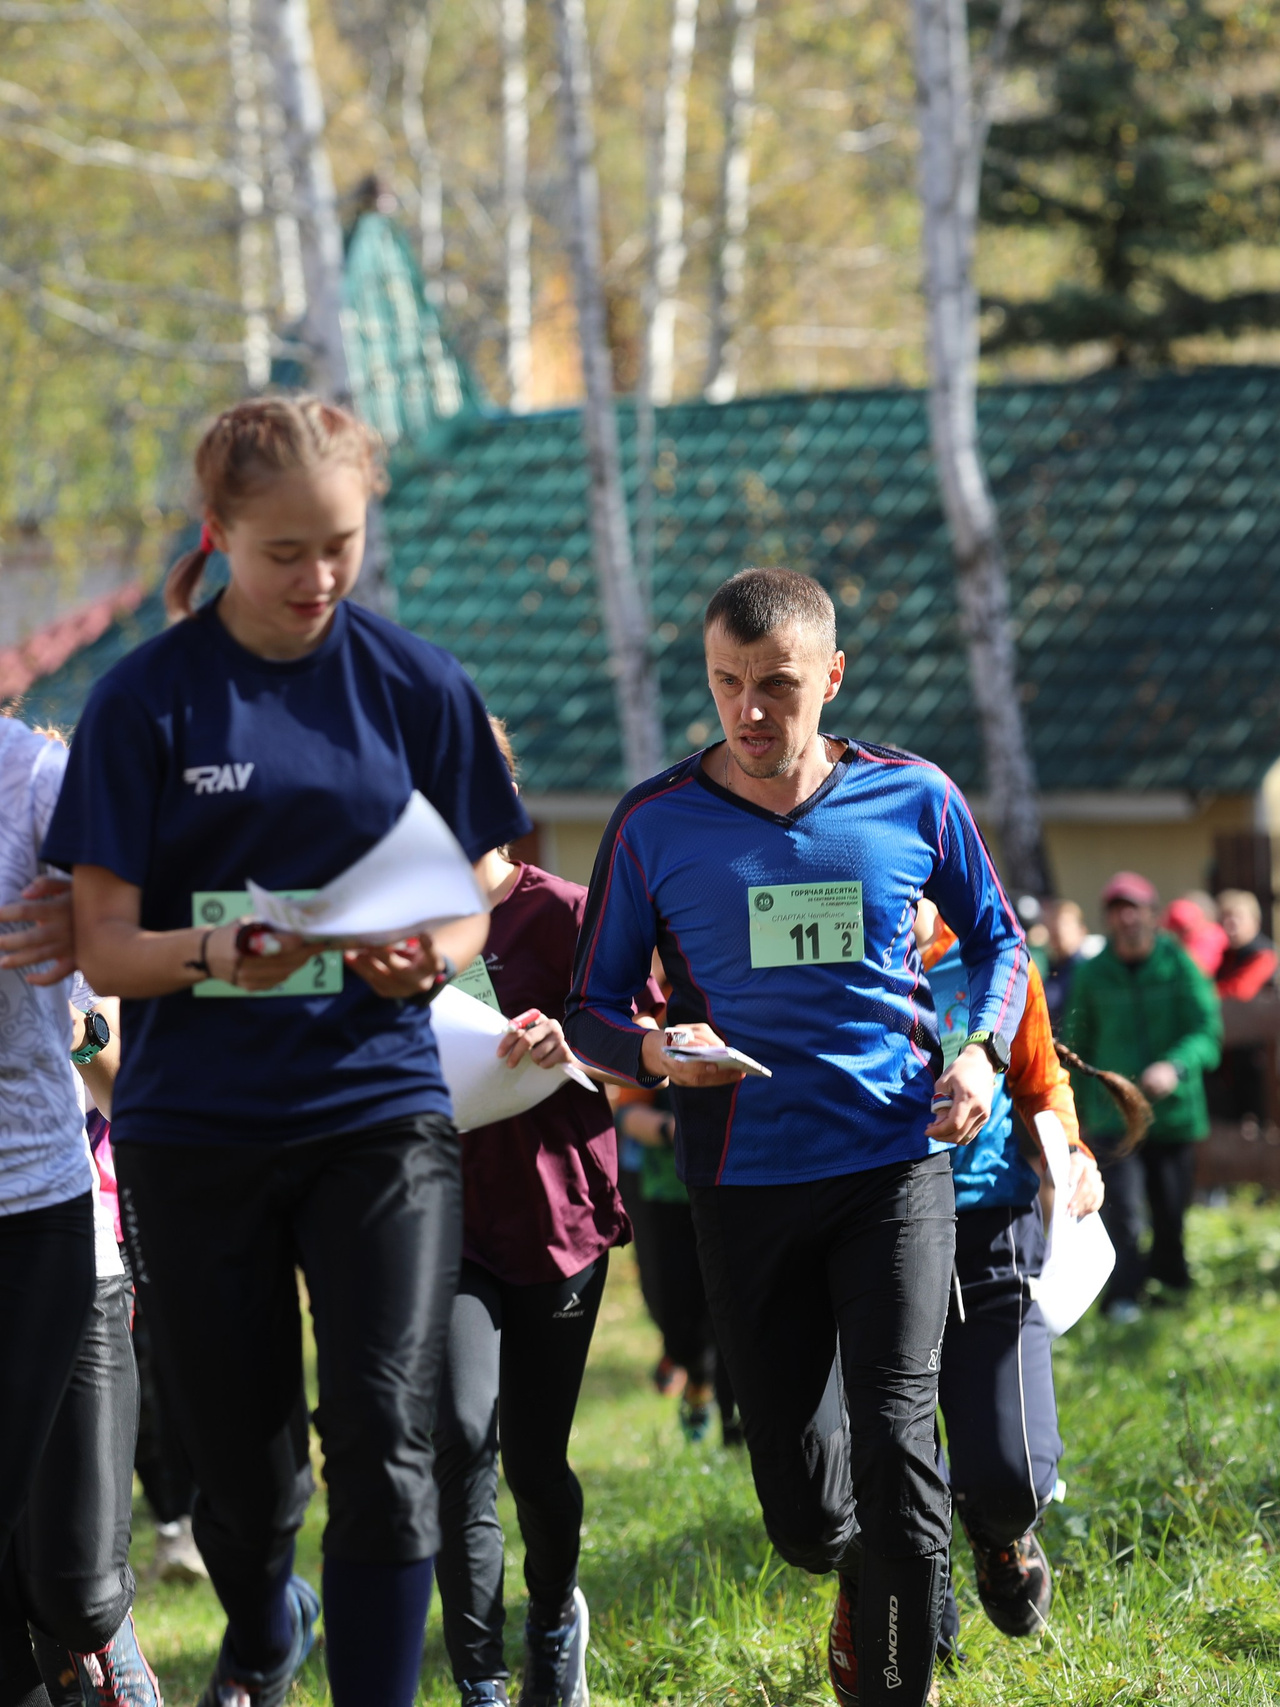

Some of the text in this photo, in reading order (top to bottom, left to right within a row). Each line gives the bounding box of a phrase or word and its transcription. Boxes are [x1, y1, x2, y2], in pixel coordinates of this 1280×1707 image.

[790, 887, 858, 897] ГОРЯЧАЯ ДЕСЯТКА
[771, 913, 806, 922] СПАРТАК
[834, 921, 859, 930] ЭТАП
[789, 922, 820, 961] 11
[841, 931, 852, 958] 2
[313, 956, 327, 989] 2
[888, 1595, 898, 1665] NORD
